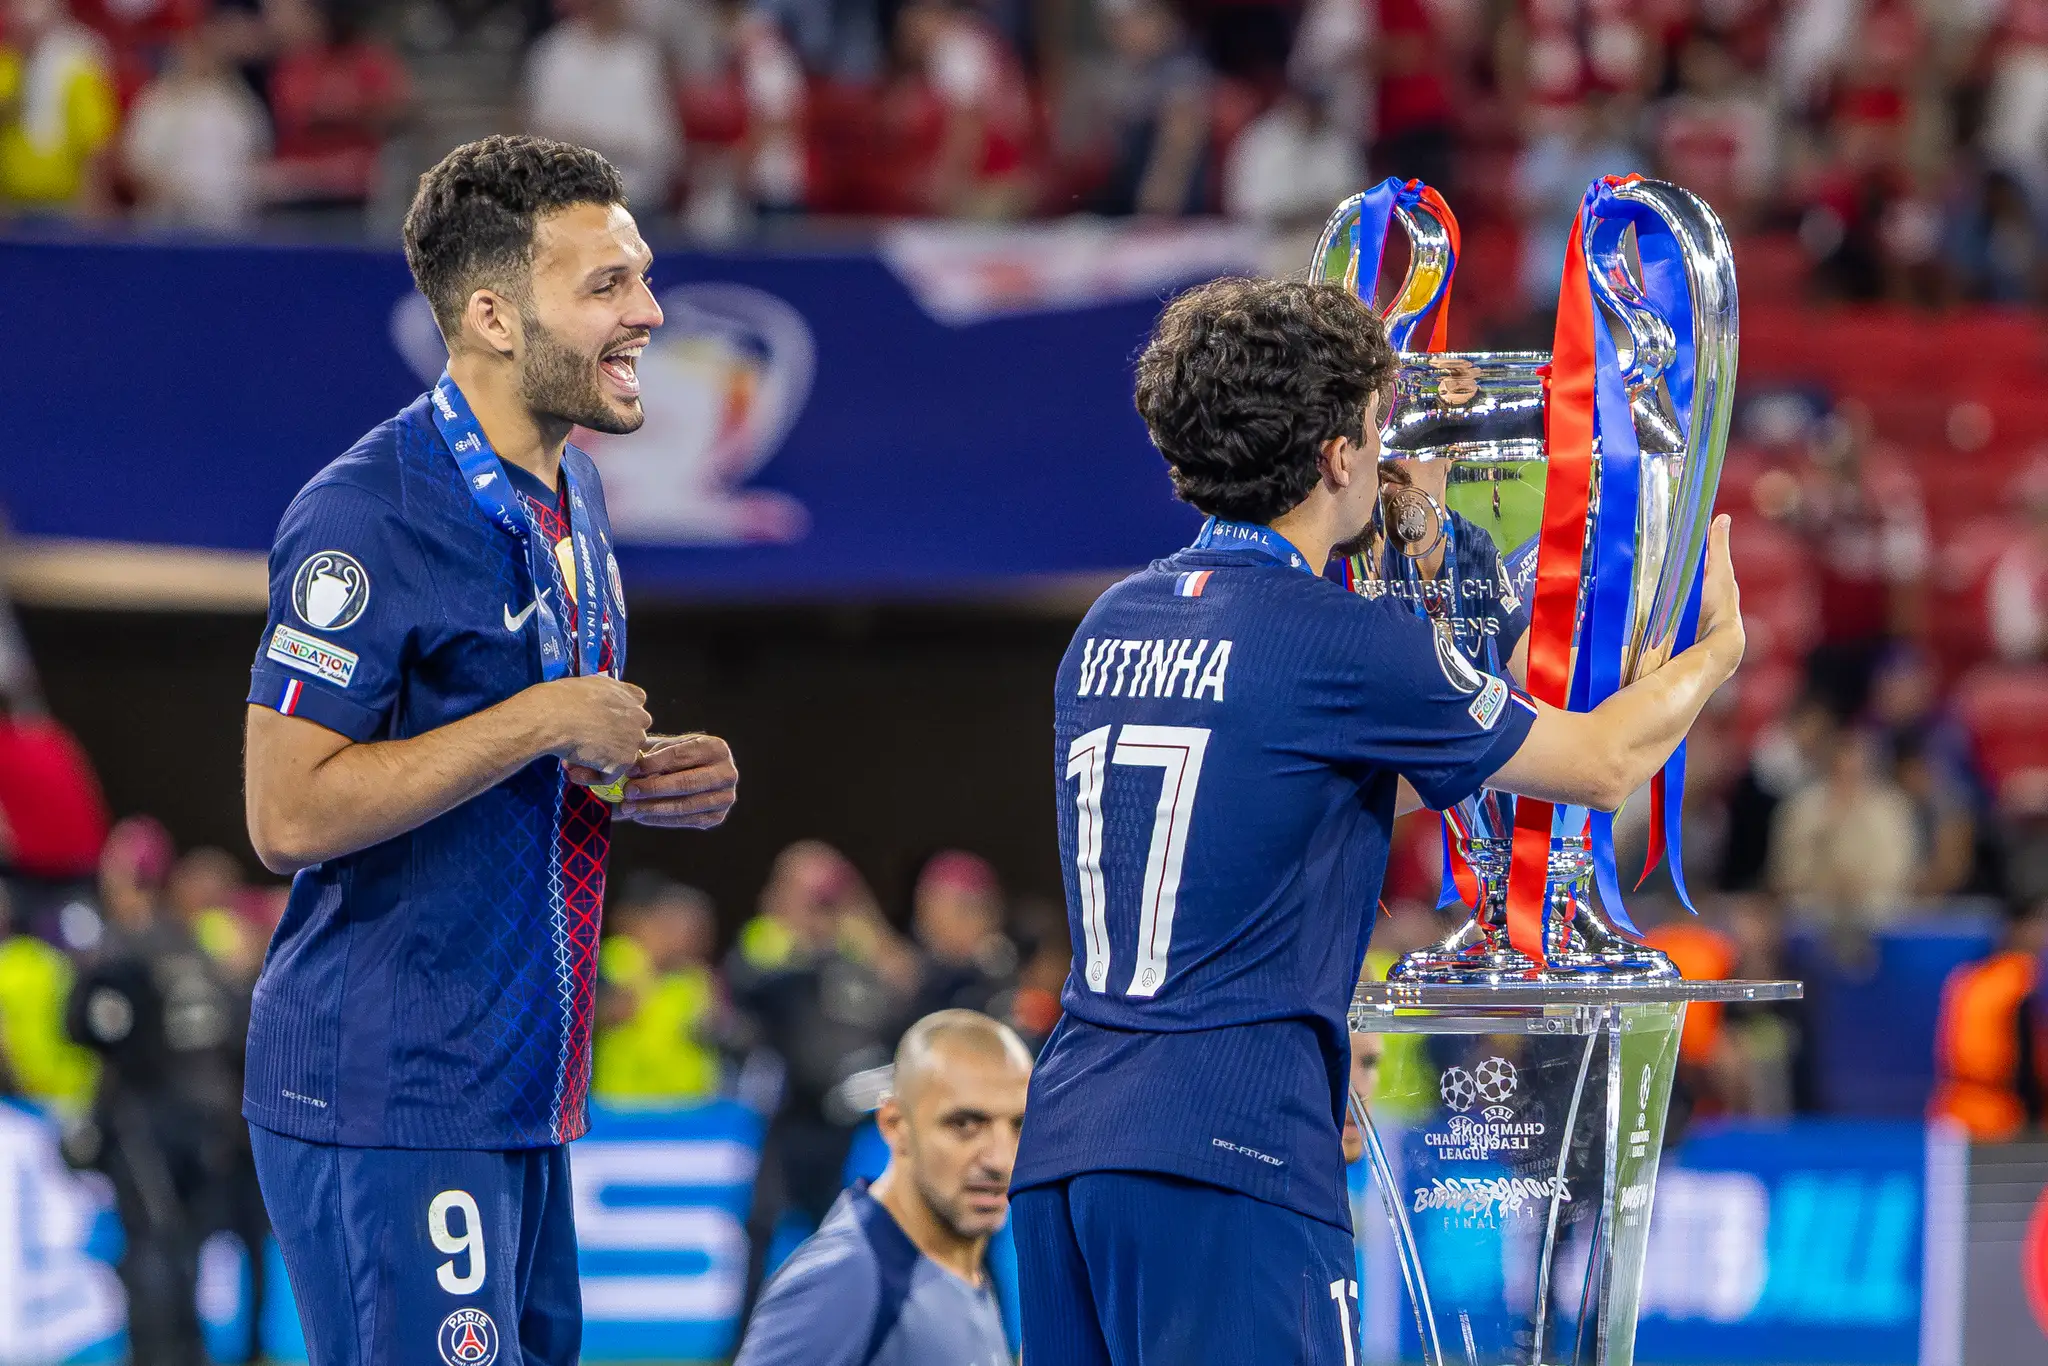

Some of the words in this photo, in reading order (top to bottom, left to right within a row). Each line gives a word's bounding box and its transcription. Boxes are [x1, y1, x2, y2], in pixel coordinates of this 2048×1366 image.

[1225, 525, 1269, 545] FINAL
[586, 600, 597, 649] FINAL
[271, 635, 352, 675] FOUNDATION
[1077, 637, 1233, 702] VITINHA
[1471, 694, 1488, 714] UEFA
[1066, 724, 1212, 996] 17
[1439, 1147, 1489, 1161] LEAGUE
[428, 1189, 486, 1295] 9
[1443, 1217, 1497, 1231] FINAL
[447, 1311, 488, 1329] PARIS
[1330, 1278, 1359, 1366] 1
